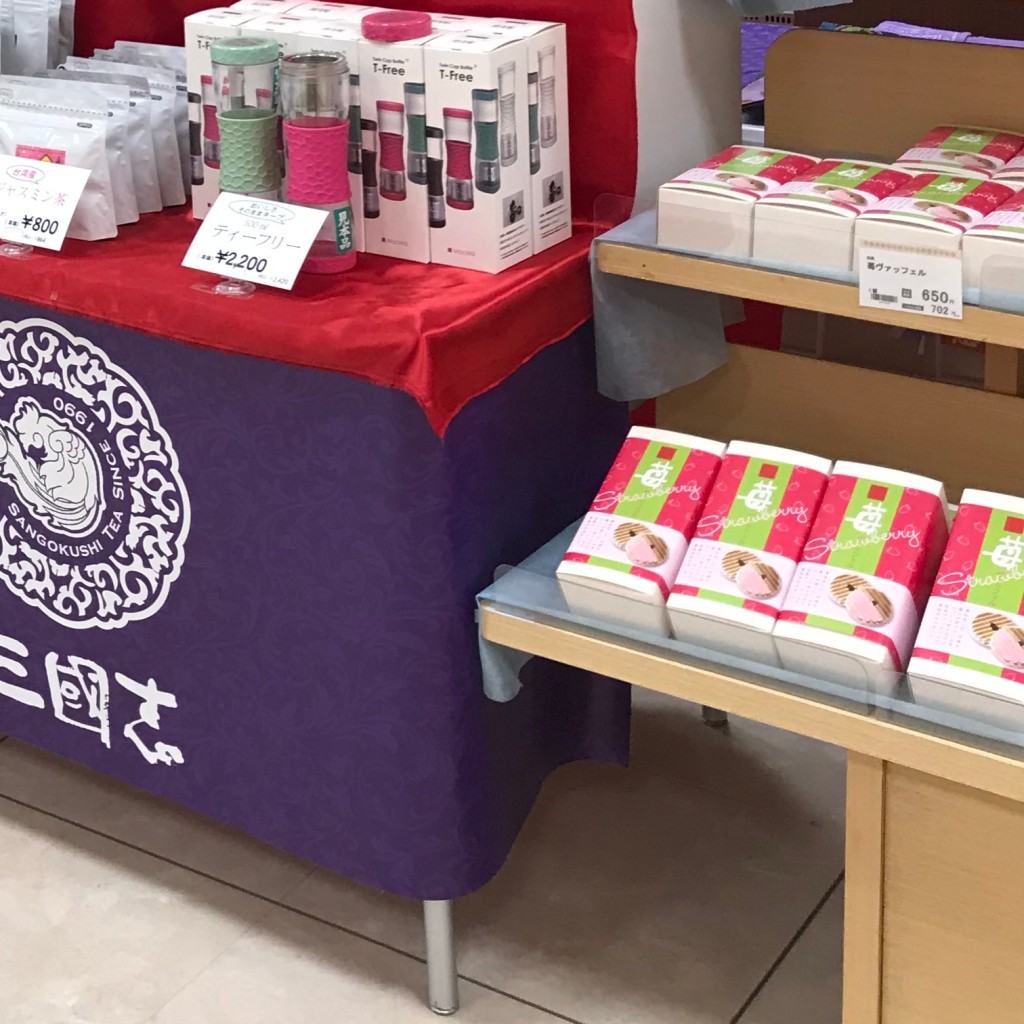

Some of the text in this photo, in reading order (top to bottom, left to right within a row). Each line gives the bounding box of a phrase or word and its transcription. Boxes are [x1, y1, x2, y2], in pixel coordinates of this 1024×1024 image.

[373, 63, 405, 76] T-Free
[439, 69, 473, 82] T-Free
[21, 214, 59, 235] ¥800
[212, 224, 301, 250] ティーフリー
[337, 210, 351, 250] 見本品
[215, 249, 268, 273] ¥2,200
[7, 396, 125, 558] SANGOKUSHI TEA SINCE 1990
[593, 484, 702, 511] Strawberry
[696, 505, 809, 537] Strawberry
[803, 528, 921, 561] Strawberry
